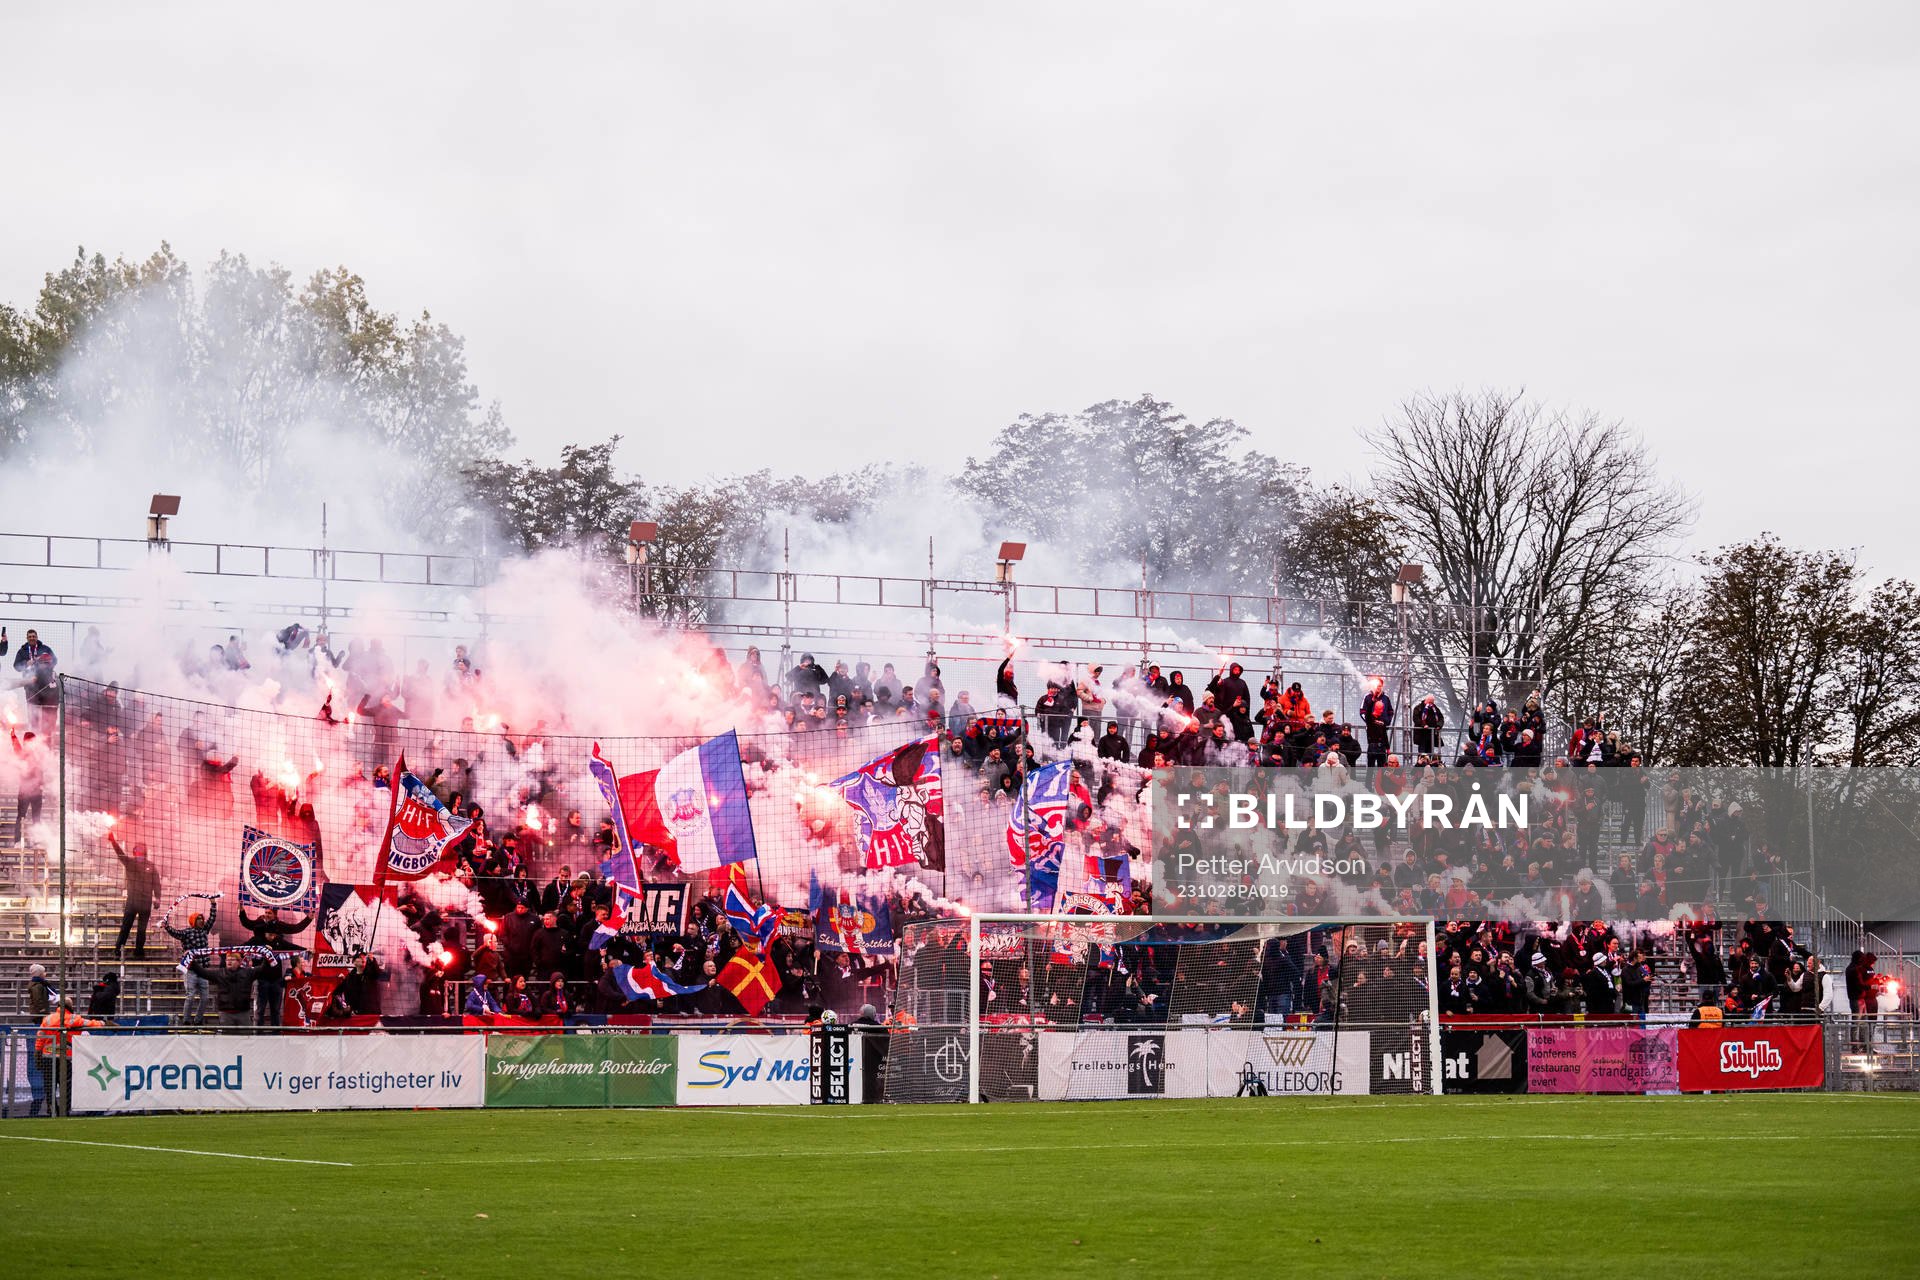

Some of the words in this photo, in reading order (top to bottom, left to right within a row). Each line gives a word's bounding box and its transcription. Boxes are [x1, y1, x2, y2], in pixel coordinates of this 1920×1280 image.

[1531, 1035, 1556, 1045] hotel
[1411, 1034, 1422, 1091] SELECT
[1531, 1049, 1577, 1059] konferens
[1721, 1041, 1781, 1078] Sibylla
[124, 1055, 243, 1100] prenad
[492, 1058, 594, 1080] Smygehamn
[598, 1058, 673, 1075] Bostäder
[687, 1050, 763, 1089] Syd
[812, 1035, 822, 1098] SELECT
[830, 1035, 845, 1098] SELECT
[1071, 1060, 1141, 1072] Trelleborgs
[1148, 1060, 1176, 1071] Hem
[1531, 1064, 1580, 1074] restaurang
[1592, 1064, 1657, 1081] strandgatan
[1662, 1066, 1673, 1080] 32
[263, 1071, 283, 1089] Vi
[288, 1075, 322, 1094] ger
[327, 1071, 435, 1093] fastigheter
[441, 1070, 462, 1088] liv
[1531, 1078, 1558, 1087] event
